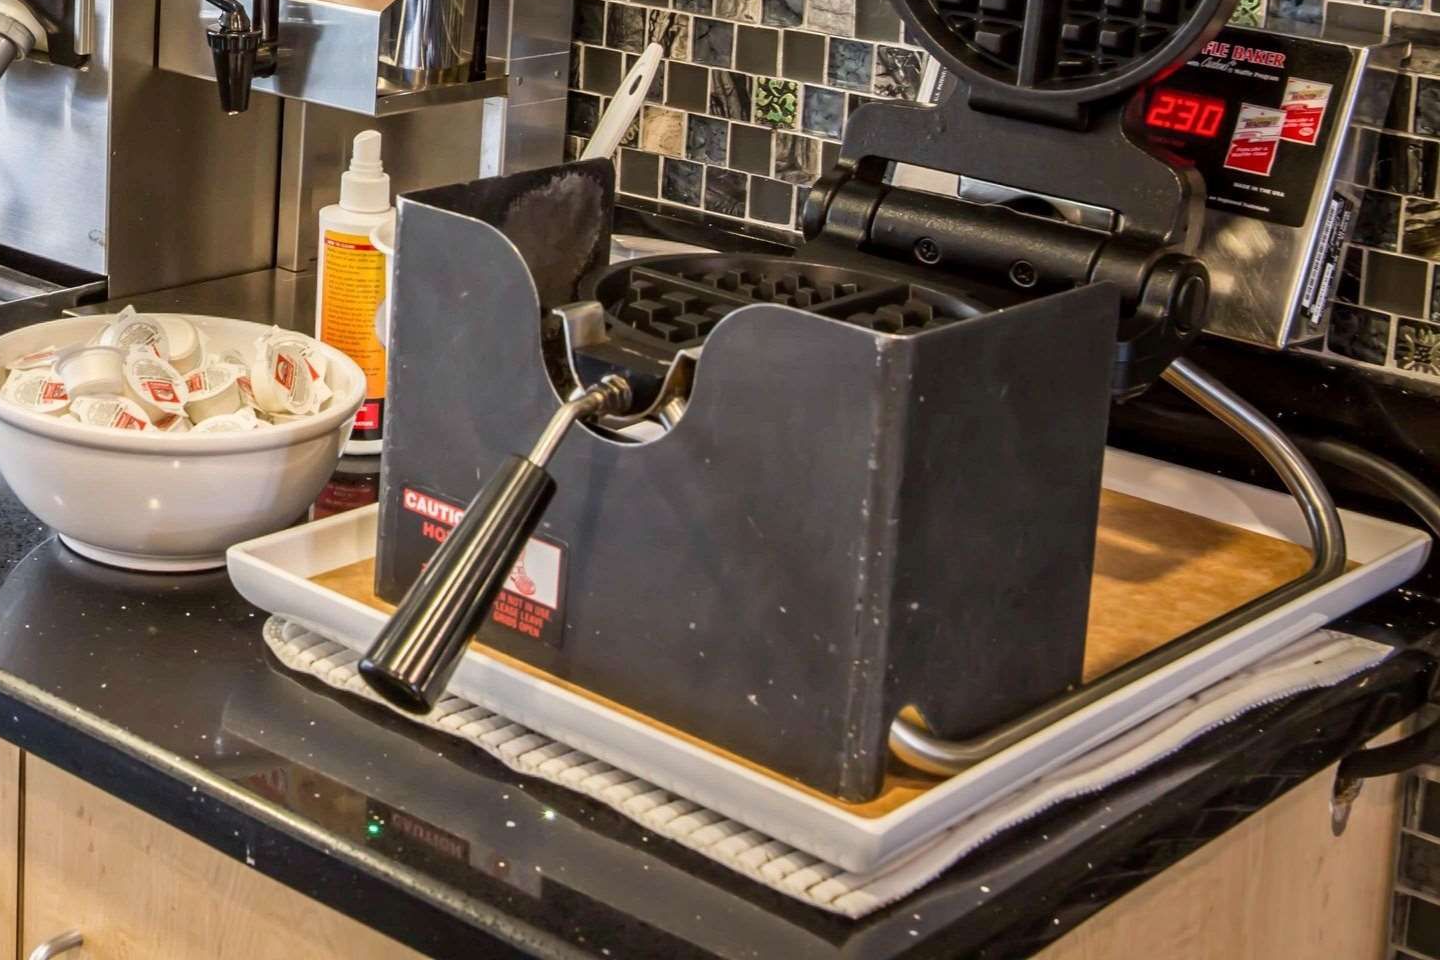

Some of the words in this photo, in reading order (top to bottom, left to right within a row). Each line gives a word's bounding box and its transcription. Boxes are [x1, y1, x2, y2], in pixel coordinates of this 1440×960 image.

[1202, 41, 1230, 58] FLE
[1231, 46, 1287, 68] BAKER
[404, 490, 464, 527] CAUTIO
[423, 521, 447, 543] HO
